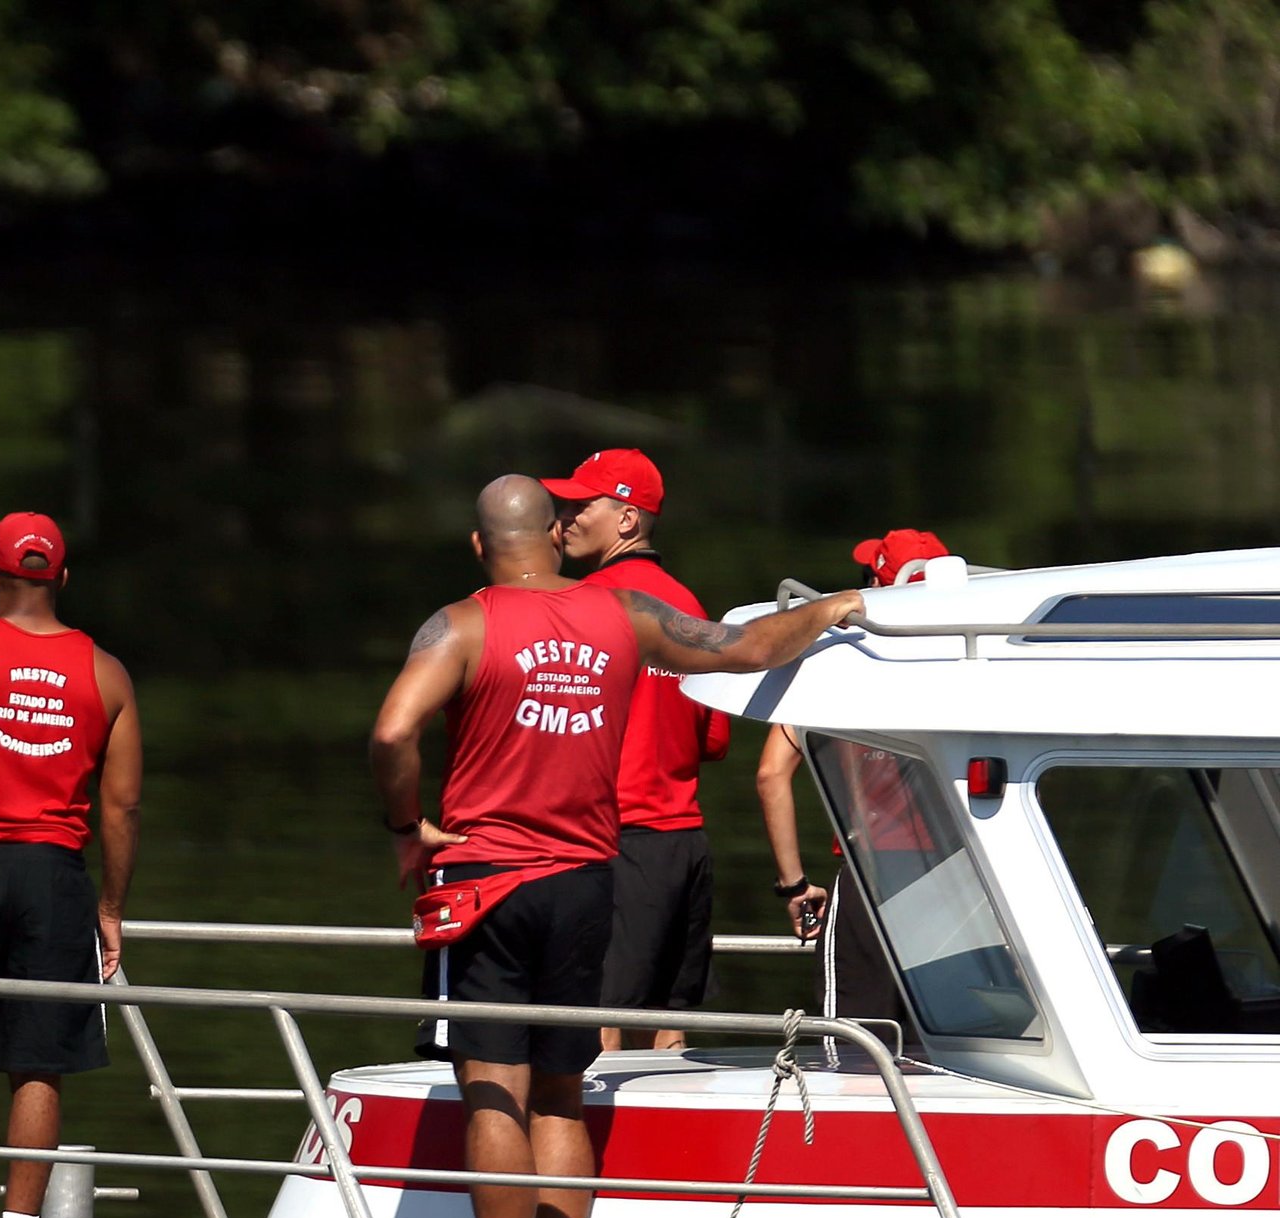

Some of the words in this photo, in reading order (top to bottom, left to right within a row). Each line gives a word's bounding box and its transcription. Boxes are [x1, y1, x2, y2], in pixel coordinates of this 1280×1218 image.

[515, 639, 610, 675] MESTRE
[10, 667, 67, 688] MESTRE
[536, 672, 571, 683] ESTADO
[574, 675, 590, 684] DO
[525, 683, 543, 692] RIO
[544, 684, 557, 693] DE
[557, 685, 601, 695] JANEIRO
[8, 692, 46, 709] ESTADO
[47, 697, 64, 711] DO
[16, 709, 30, 722] DE
[30, 711, 74, 728] JANEIRO
[515, 698, 604, 735] GMar
[1104, 1118, 1280, 1206] CO
